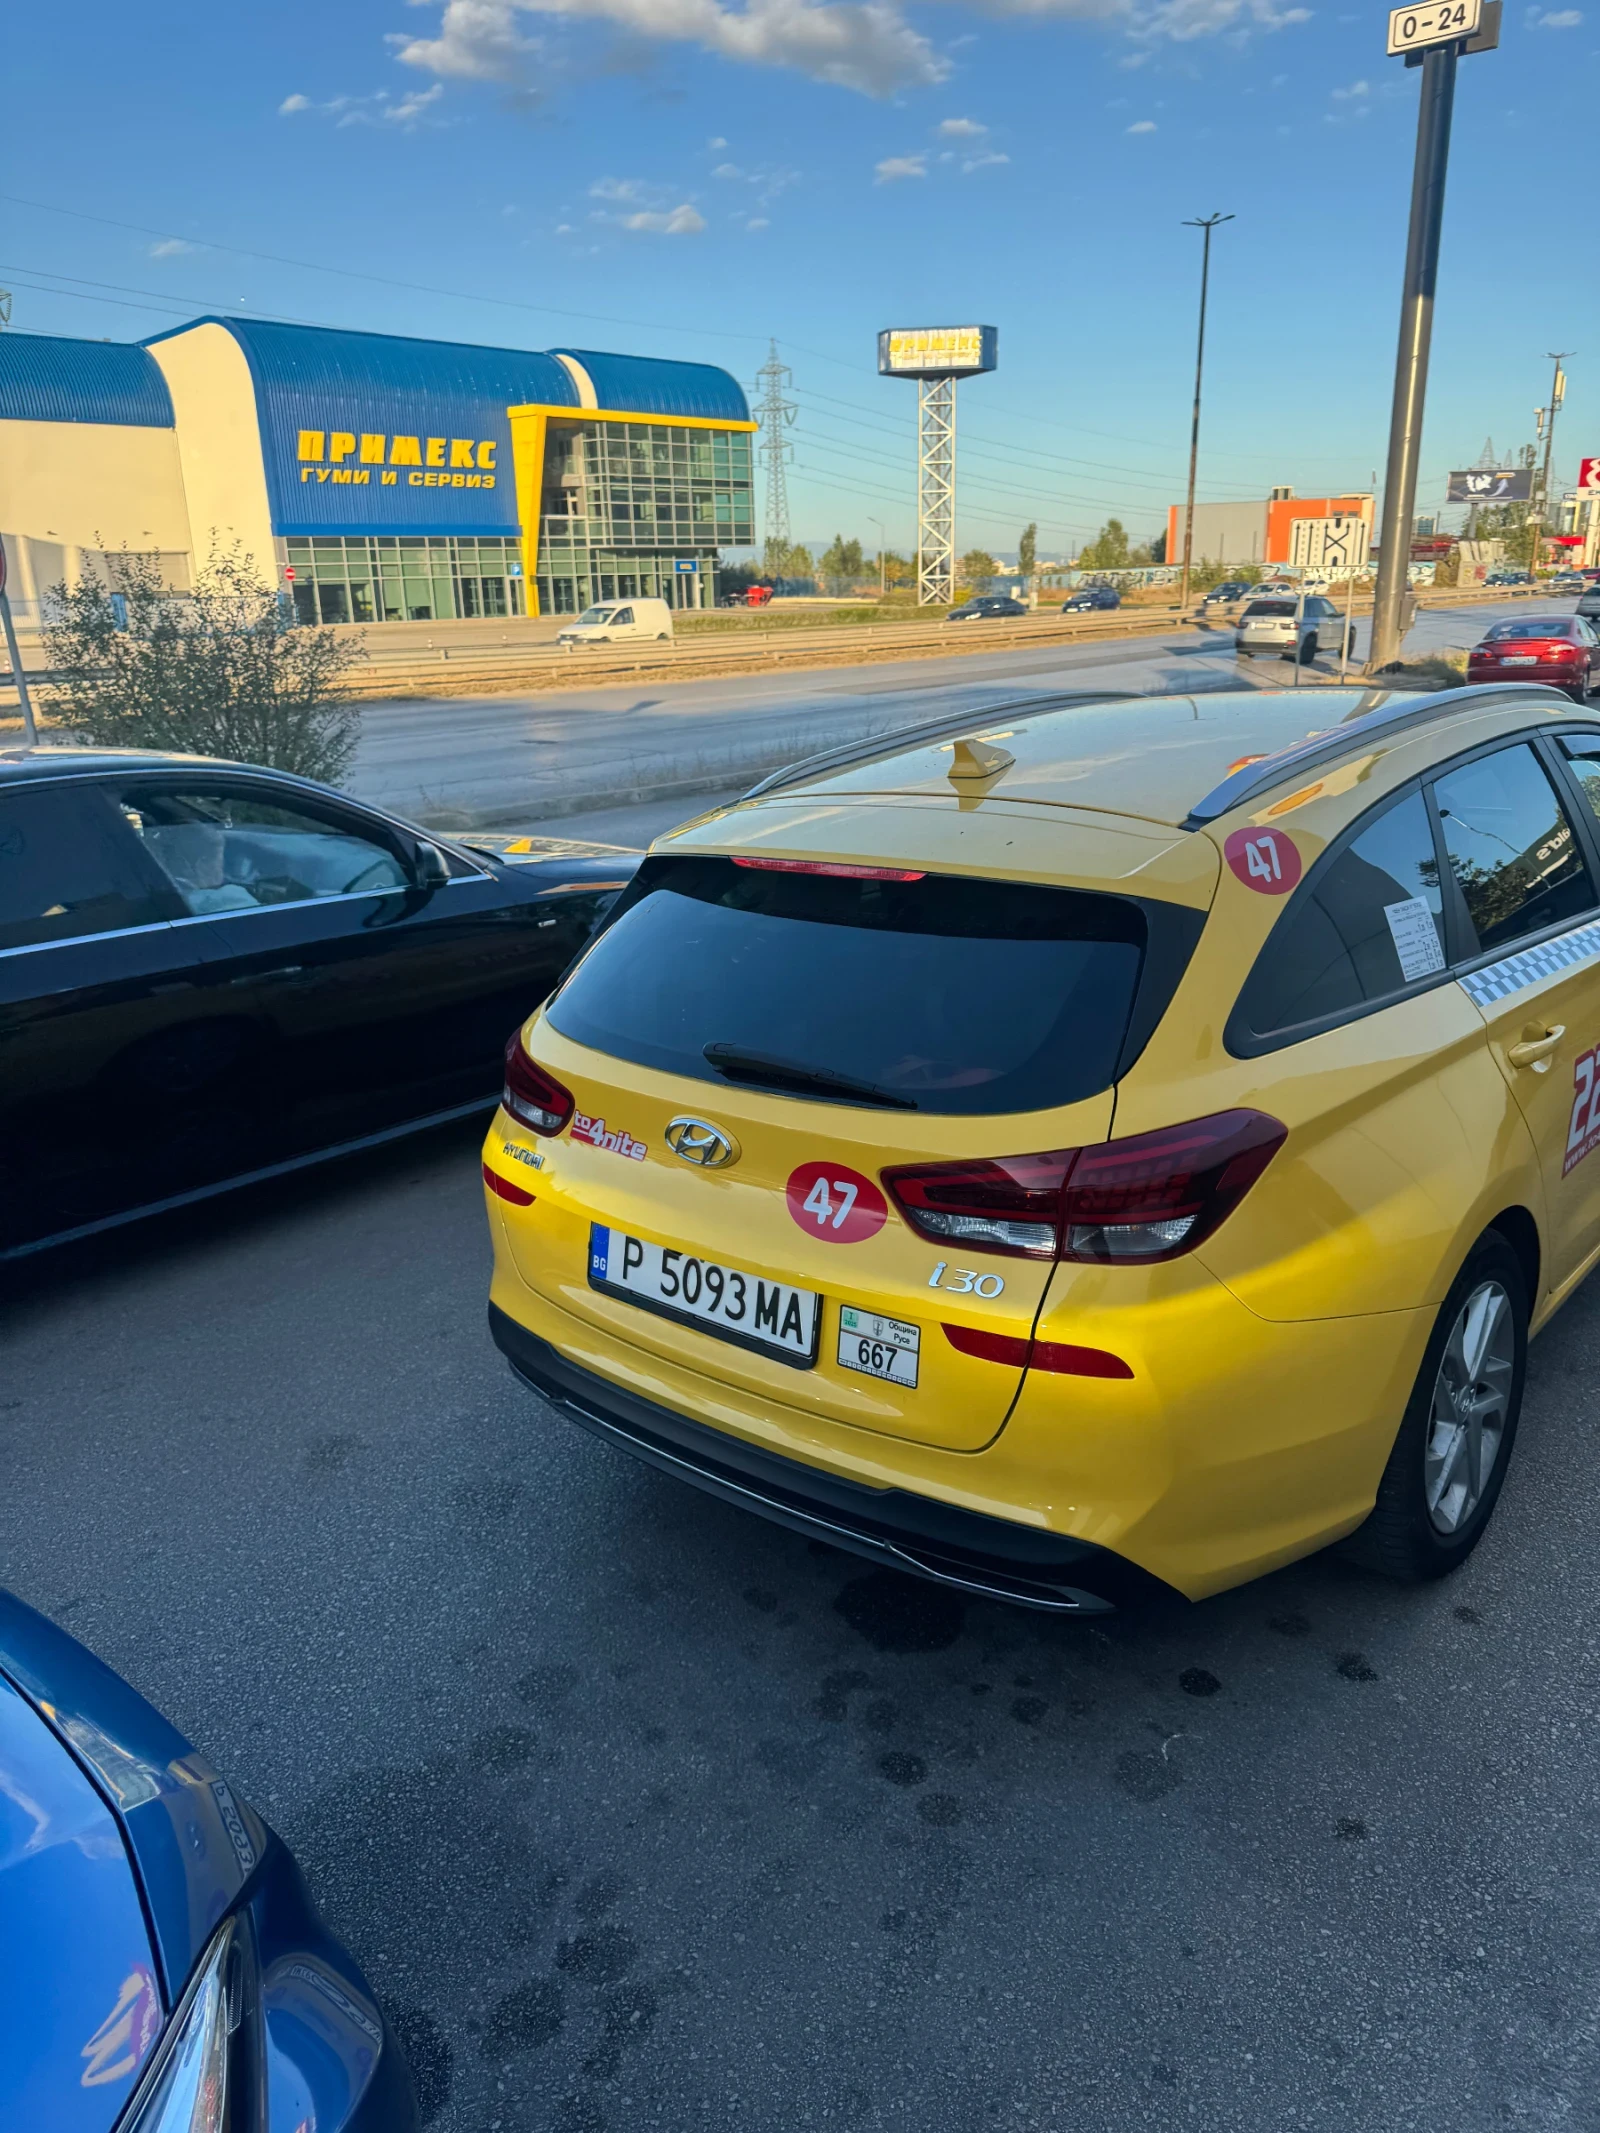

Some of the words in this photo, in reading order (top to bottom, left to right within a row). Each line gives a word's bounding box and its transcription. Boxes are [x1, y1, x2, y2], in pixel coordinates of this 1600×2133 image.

[298, 430, 497, 469] ПРИМЕКС
[301, 468, 370, 484] ГУМИ
[381, 471, 397, 485] И
[408, 472, 495, 488] СЕРВИЗ
[1245, 836, 1281, 882] 47
[574, 1110, 647, 1161] to4nite
[803, 1177, 858, 1229] 47
[593, 1255, 606, 1271] BG
[622, 1236, 644, 1280] P
[660, 1248, 746, 1320] 5093
[888, 1321, 917, 1336] Община
[893, 1333, 911, 1344] Русе
[858, 1339, 898, 1372] 667
